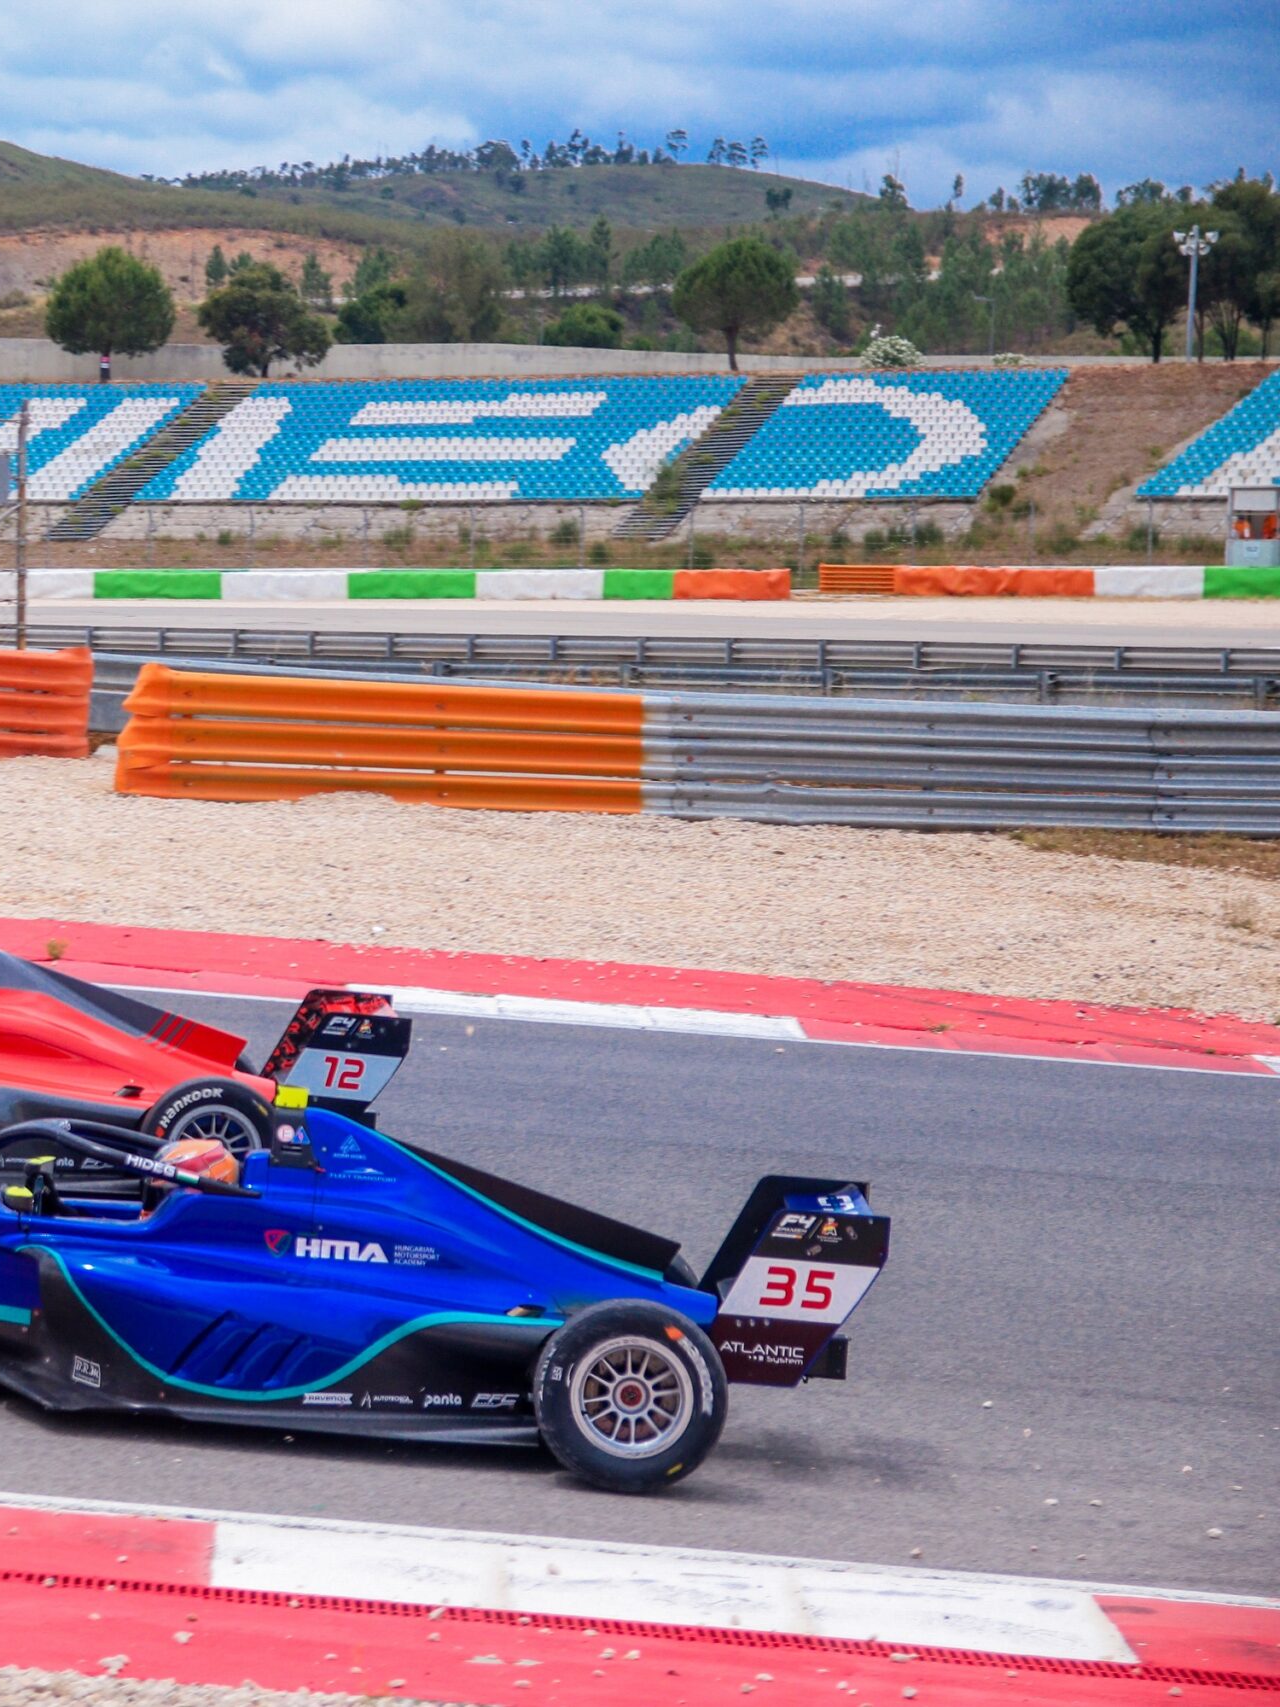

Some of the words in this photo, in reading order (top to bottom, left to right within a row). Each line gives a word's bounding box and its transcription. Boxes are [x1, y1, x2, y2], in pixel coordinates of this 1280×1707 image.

[328, 1015, 356, 1027] F4
[324, 1055, 365, 1091] 12
[125, 1153, 176, 1178] HIDEG
[779, 1213, 817, 1228] F4
[295, 1236, 389, 1264] HMA
[393, 1251, 440, 1261] MOTORSPORT
[394, 1244, 435, 1254] HUNGARIAN
[393, 1258, 426, 1267] ACADEMY
[759, 1265, 836, 1311] 35
[720, 1340, 805, 1359] ATLANTIC
[423, 1392, 462, 1408] panta
